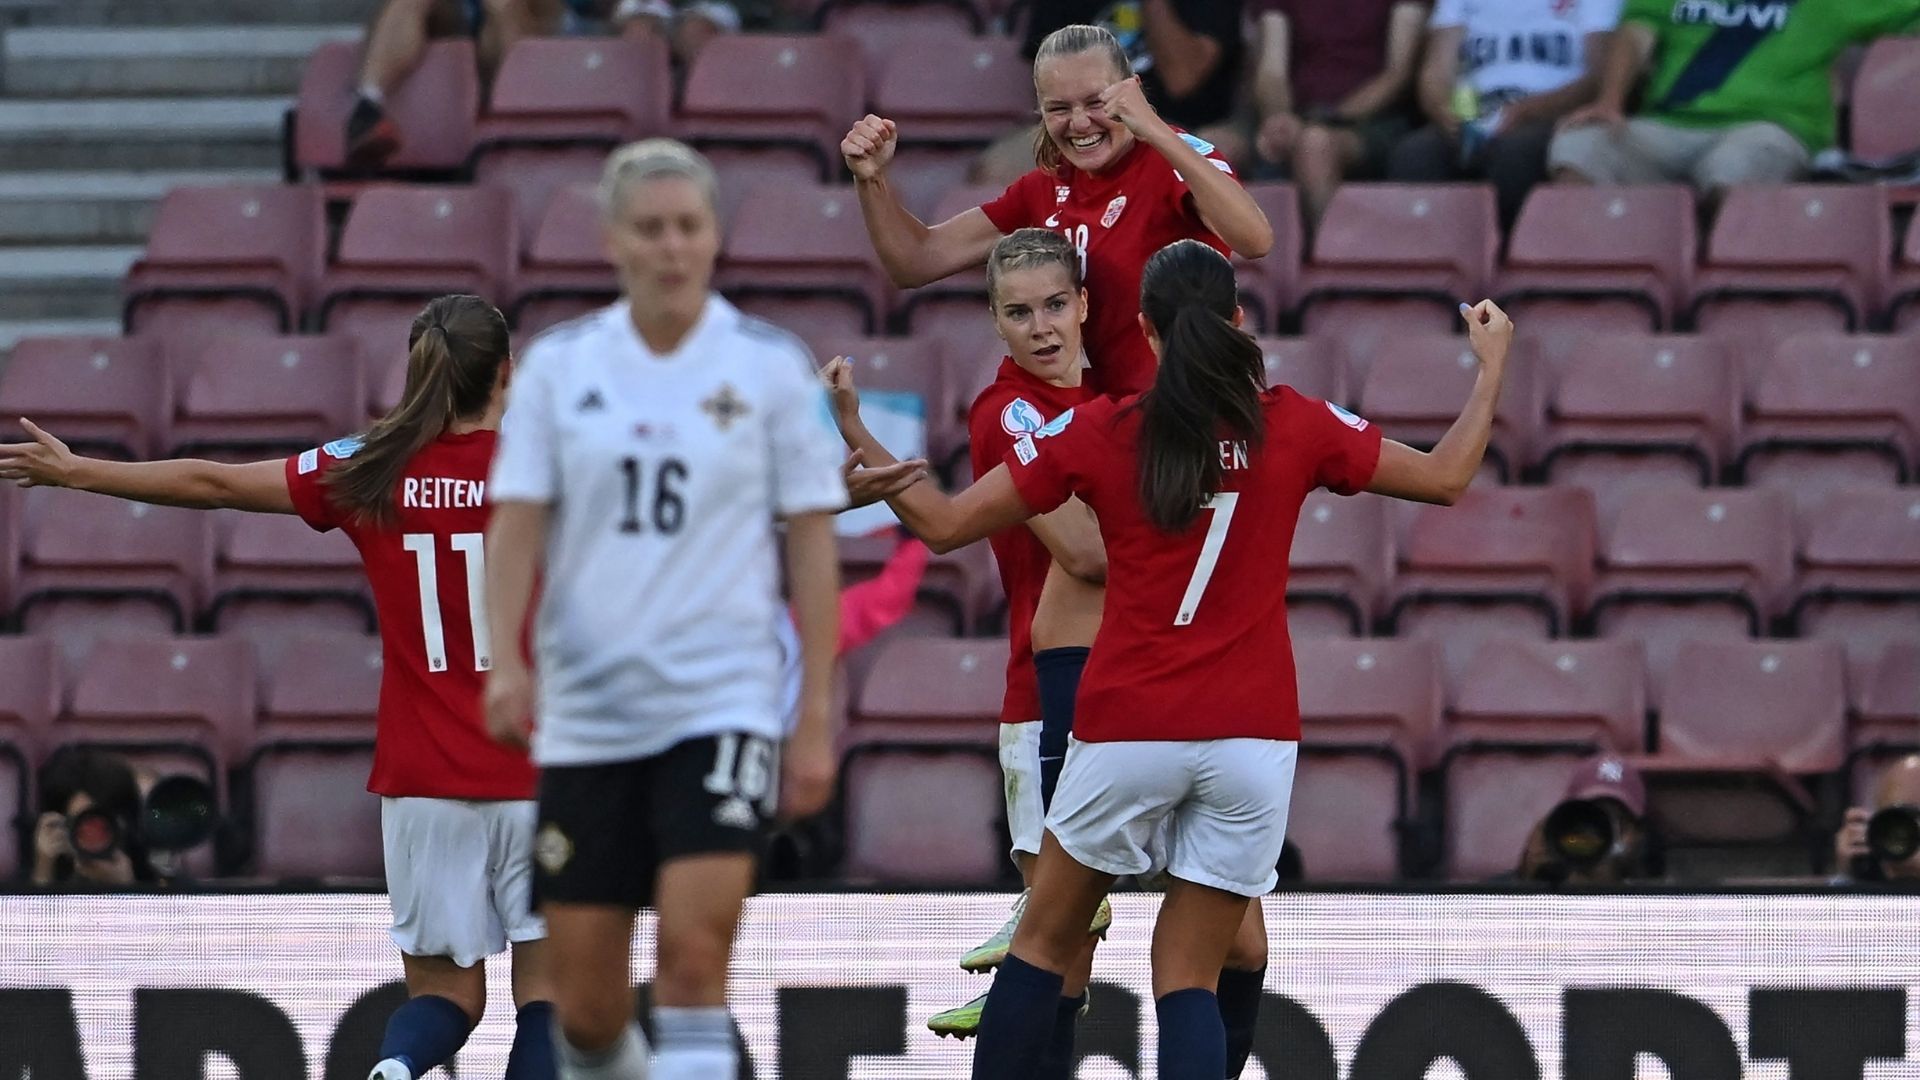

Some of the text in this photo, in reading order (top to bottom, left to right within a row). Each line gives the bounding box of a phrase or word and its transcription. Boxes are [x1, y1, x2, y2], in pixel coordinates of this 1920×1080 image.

[1218, 440, 1249, 470] EN
[403, 476, 485, 508] REITEN
[617, 456, 689, 536] 16
[1173, 491, 1240, 626] 7
[402, 532, 493, 672] 11
[703, 733, 771, 797] 16
